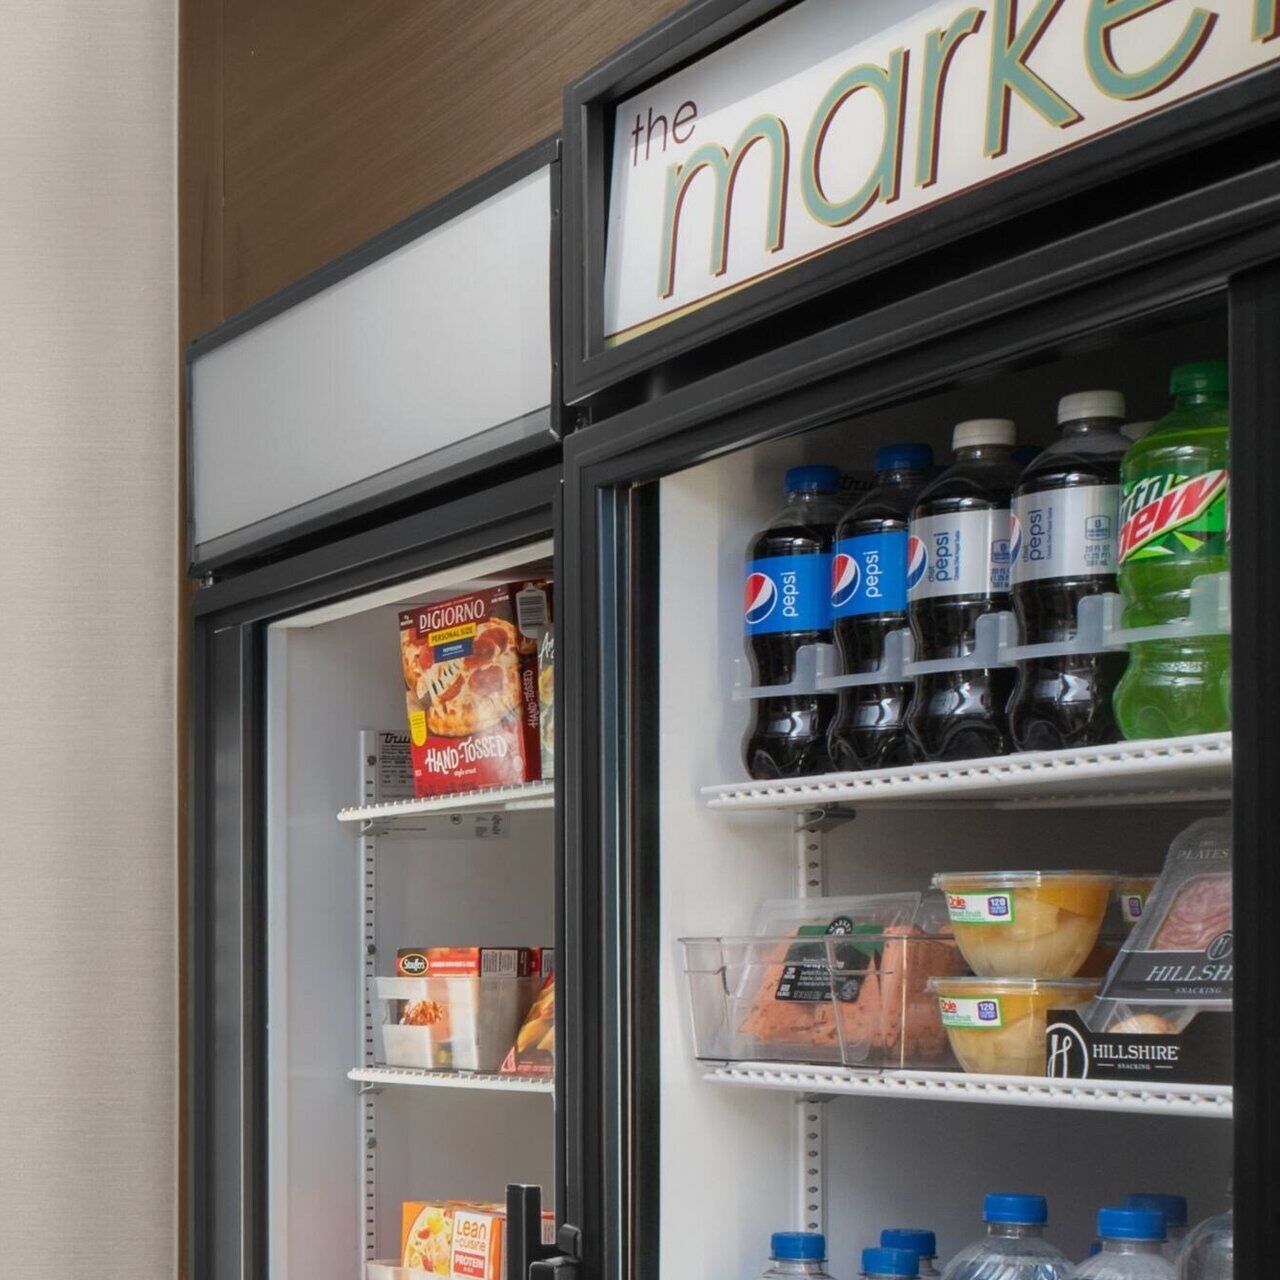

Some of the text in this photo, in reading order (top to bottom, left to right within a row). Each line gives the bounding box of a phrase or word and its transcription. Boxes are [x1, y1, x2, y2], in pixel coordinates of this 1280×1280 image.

[630, 100, 698, 166] the
[658, 0, 1280, 298] marke
[1029, 508, 1044, 562] pepsi
[863, 550, 882, 598] pepsi
[936, 531, 950, 582] pepsi
[781, 572, 799, 617] pepsi
[419, 599, 485, 632] DIGIORNO
[431, 626, 473, 643] PERSONAL SIZE
[523, 669, 538, 729] HAND-TOSSED
[425, 735, 507, 774] HAND-TOSSED
[990, 899, 1005, 907] 120
[1146, 966, 1233, 982] HILLSH
[1092, 1045, 1178, 1061] HILLSHIRE
[457, 1219, 487, 1240] Lean
[455, 1254, 484, 1268] PROTEIN
